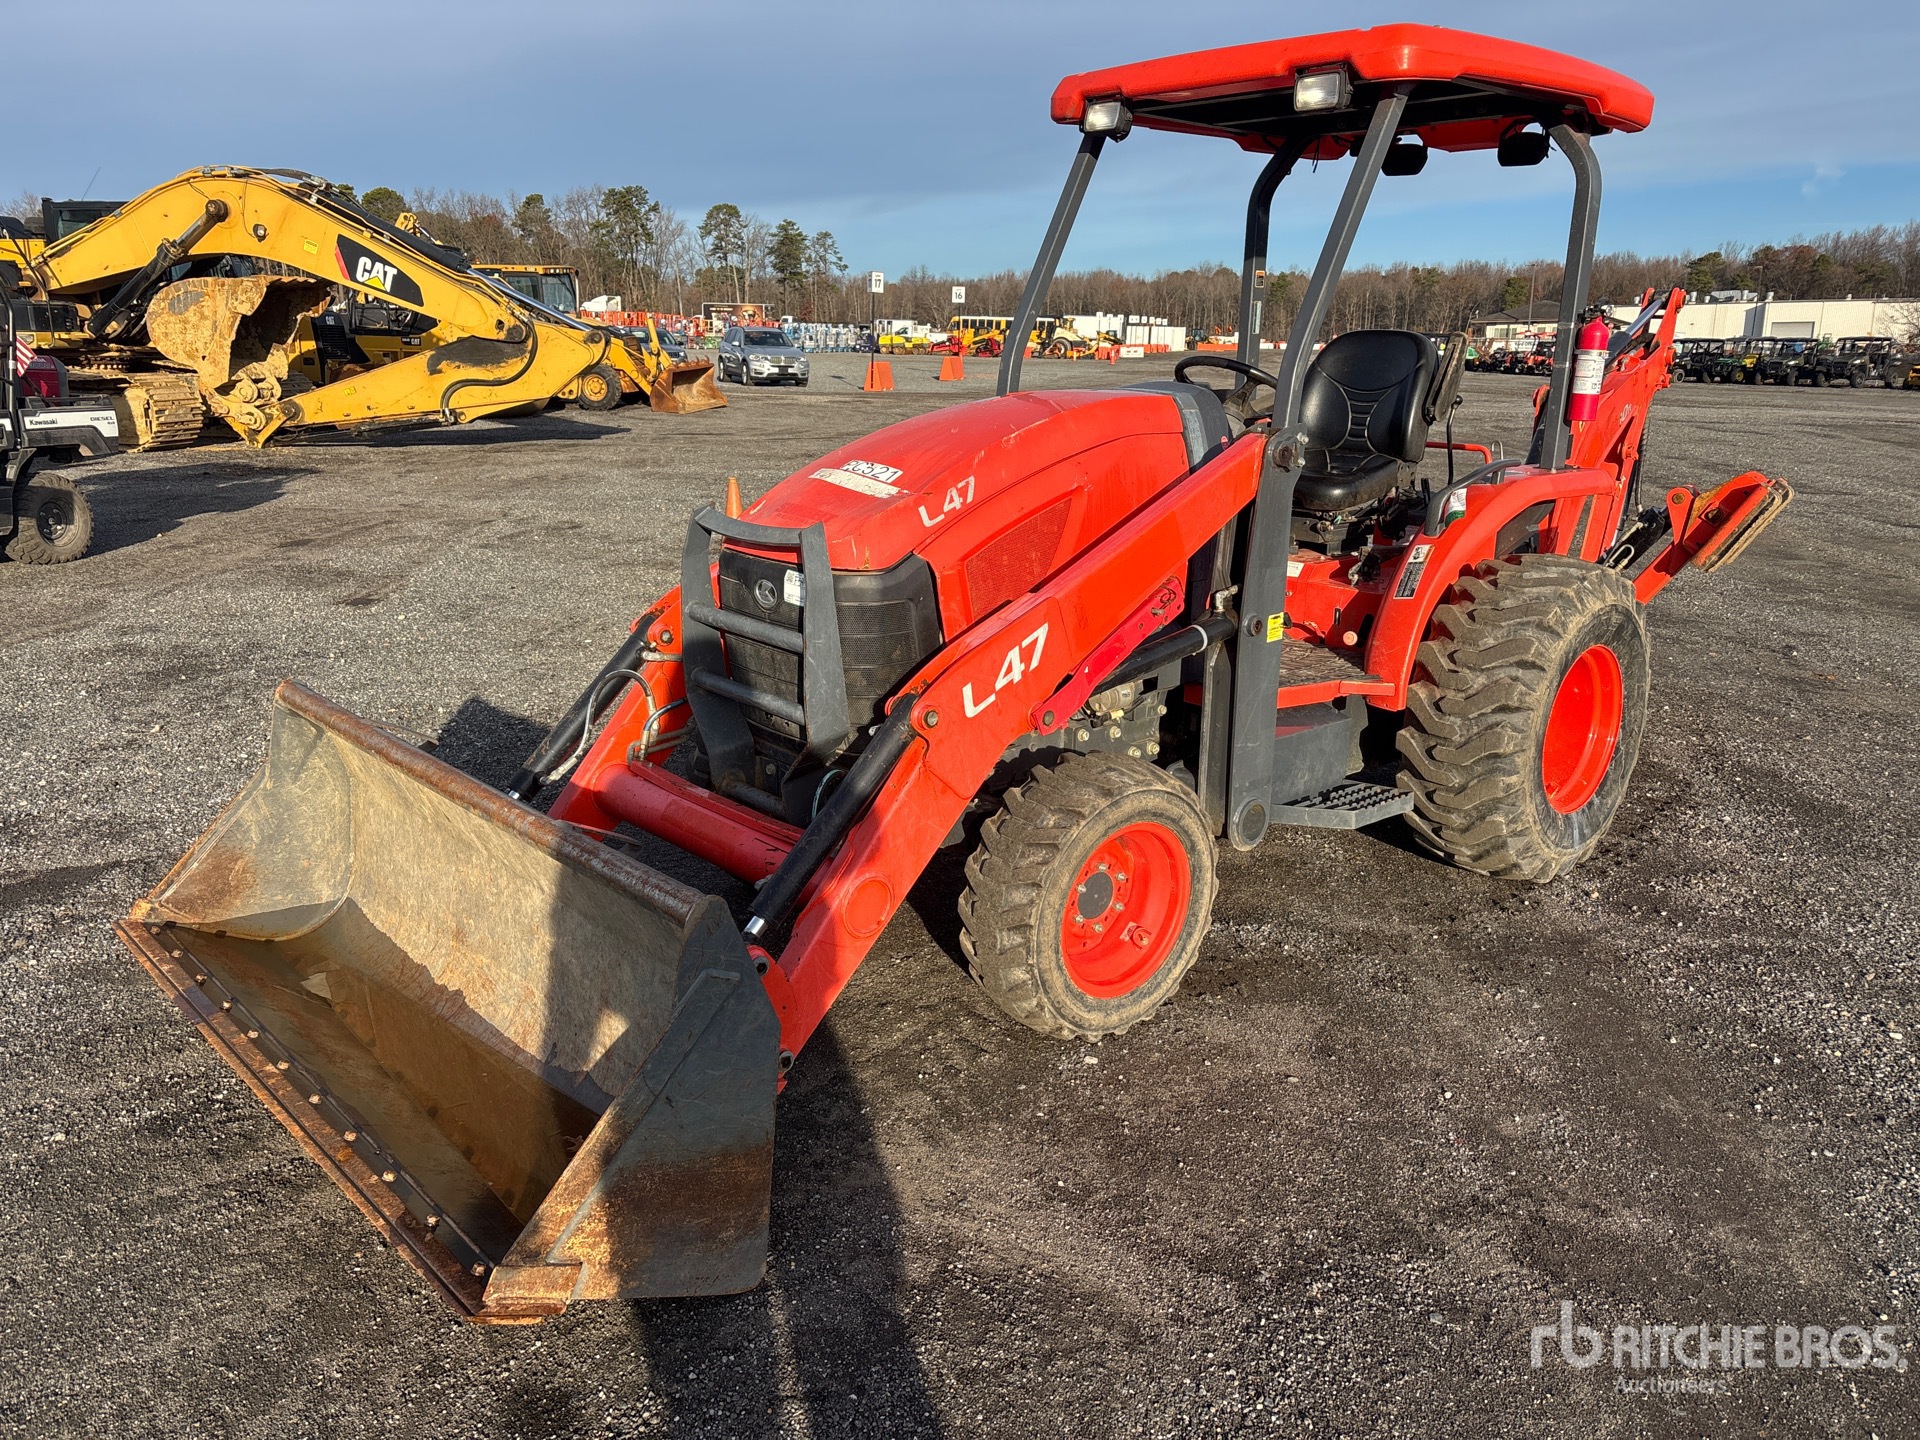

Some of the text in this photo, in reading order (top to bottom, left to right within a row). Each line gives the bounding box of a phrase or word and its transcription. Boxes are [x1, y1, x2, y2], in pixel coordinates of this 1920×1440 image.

[355, 256, 398, 293] CAT
[874, 278, 882, 288] 17
[954, 291, 963, 300] 16
[410, 337, 420, 345] CAT
[29, 418, 59, 426] Kawasaki
[917, 475, 975, 528] L47
[961, 621, 1049, 719] L47
